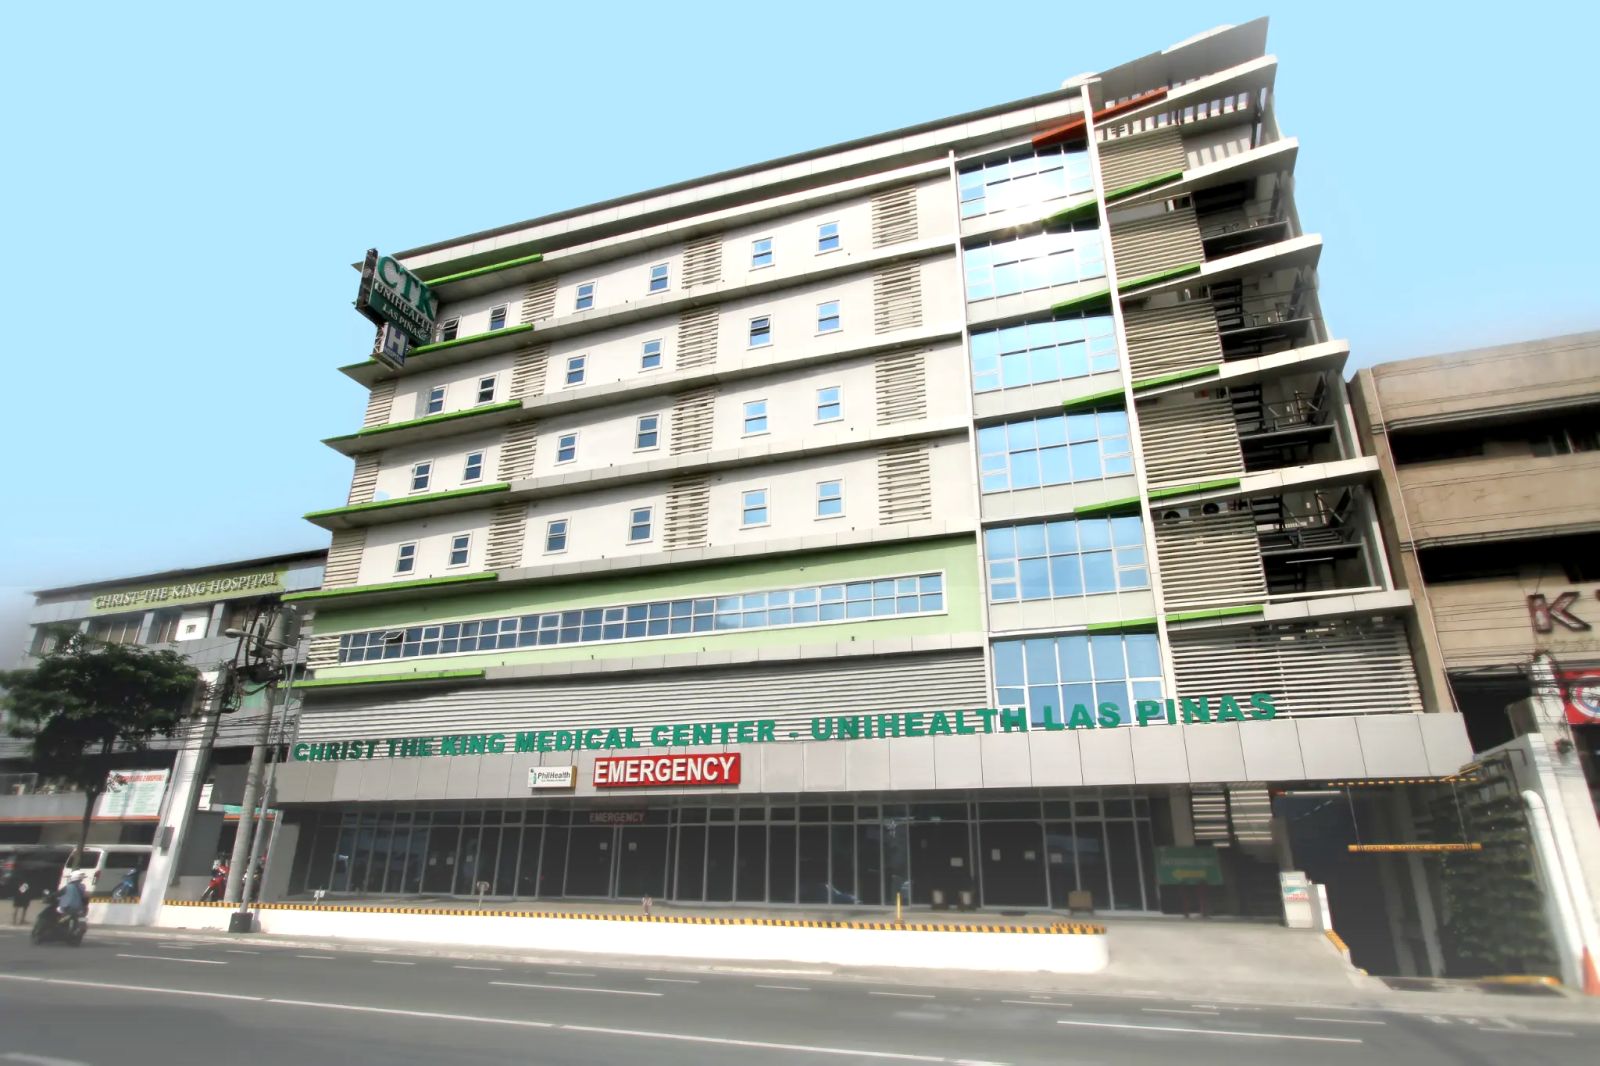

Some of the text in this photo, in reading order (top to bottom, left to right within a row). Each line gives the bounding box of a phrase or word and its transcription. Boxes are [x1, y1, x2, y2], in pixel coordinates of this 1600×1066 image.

[382, 303, 398, 320] LAS
[95, 572, 278, 609] CHRIST THE KING HOSPITAL
[293, 740, 379, 762] CHRIST
[386, 737, 434, 758] THE
[440, 733, 505, 756] KING
[514, 727, 641, 752] MEDICAL
[650, 719, 776, 746] CENTER
[811, 707, 1028, 741] UNIHEALTH
[1043, 701, 1121, 731] LAS
[1136, 692, 1276, 727] PINAS
[594, 756, 735, 784] EMERGENCY
